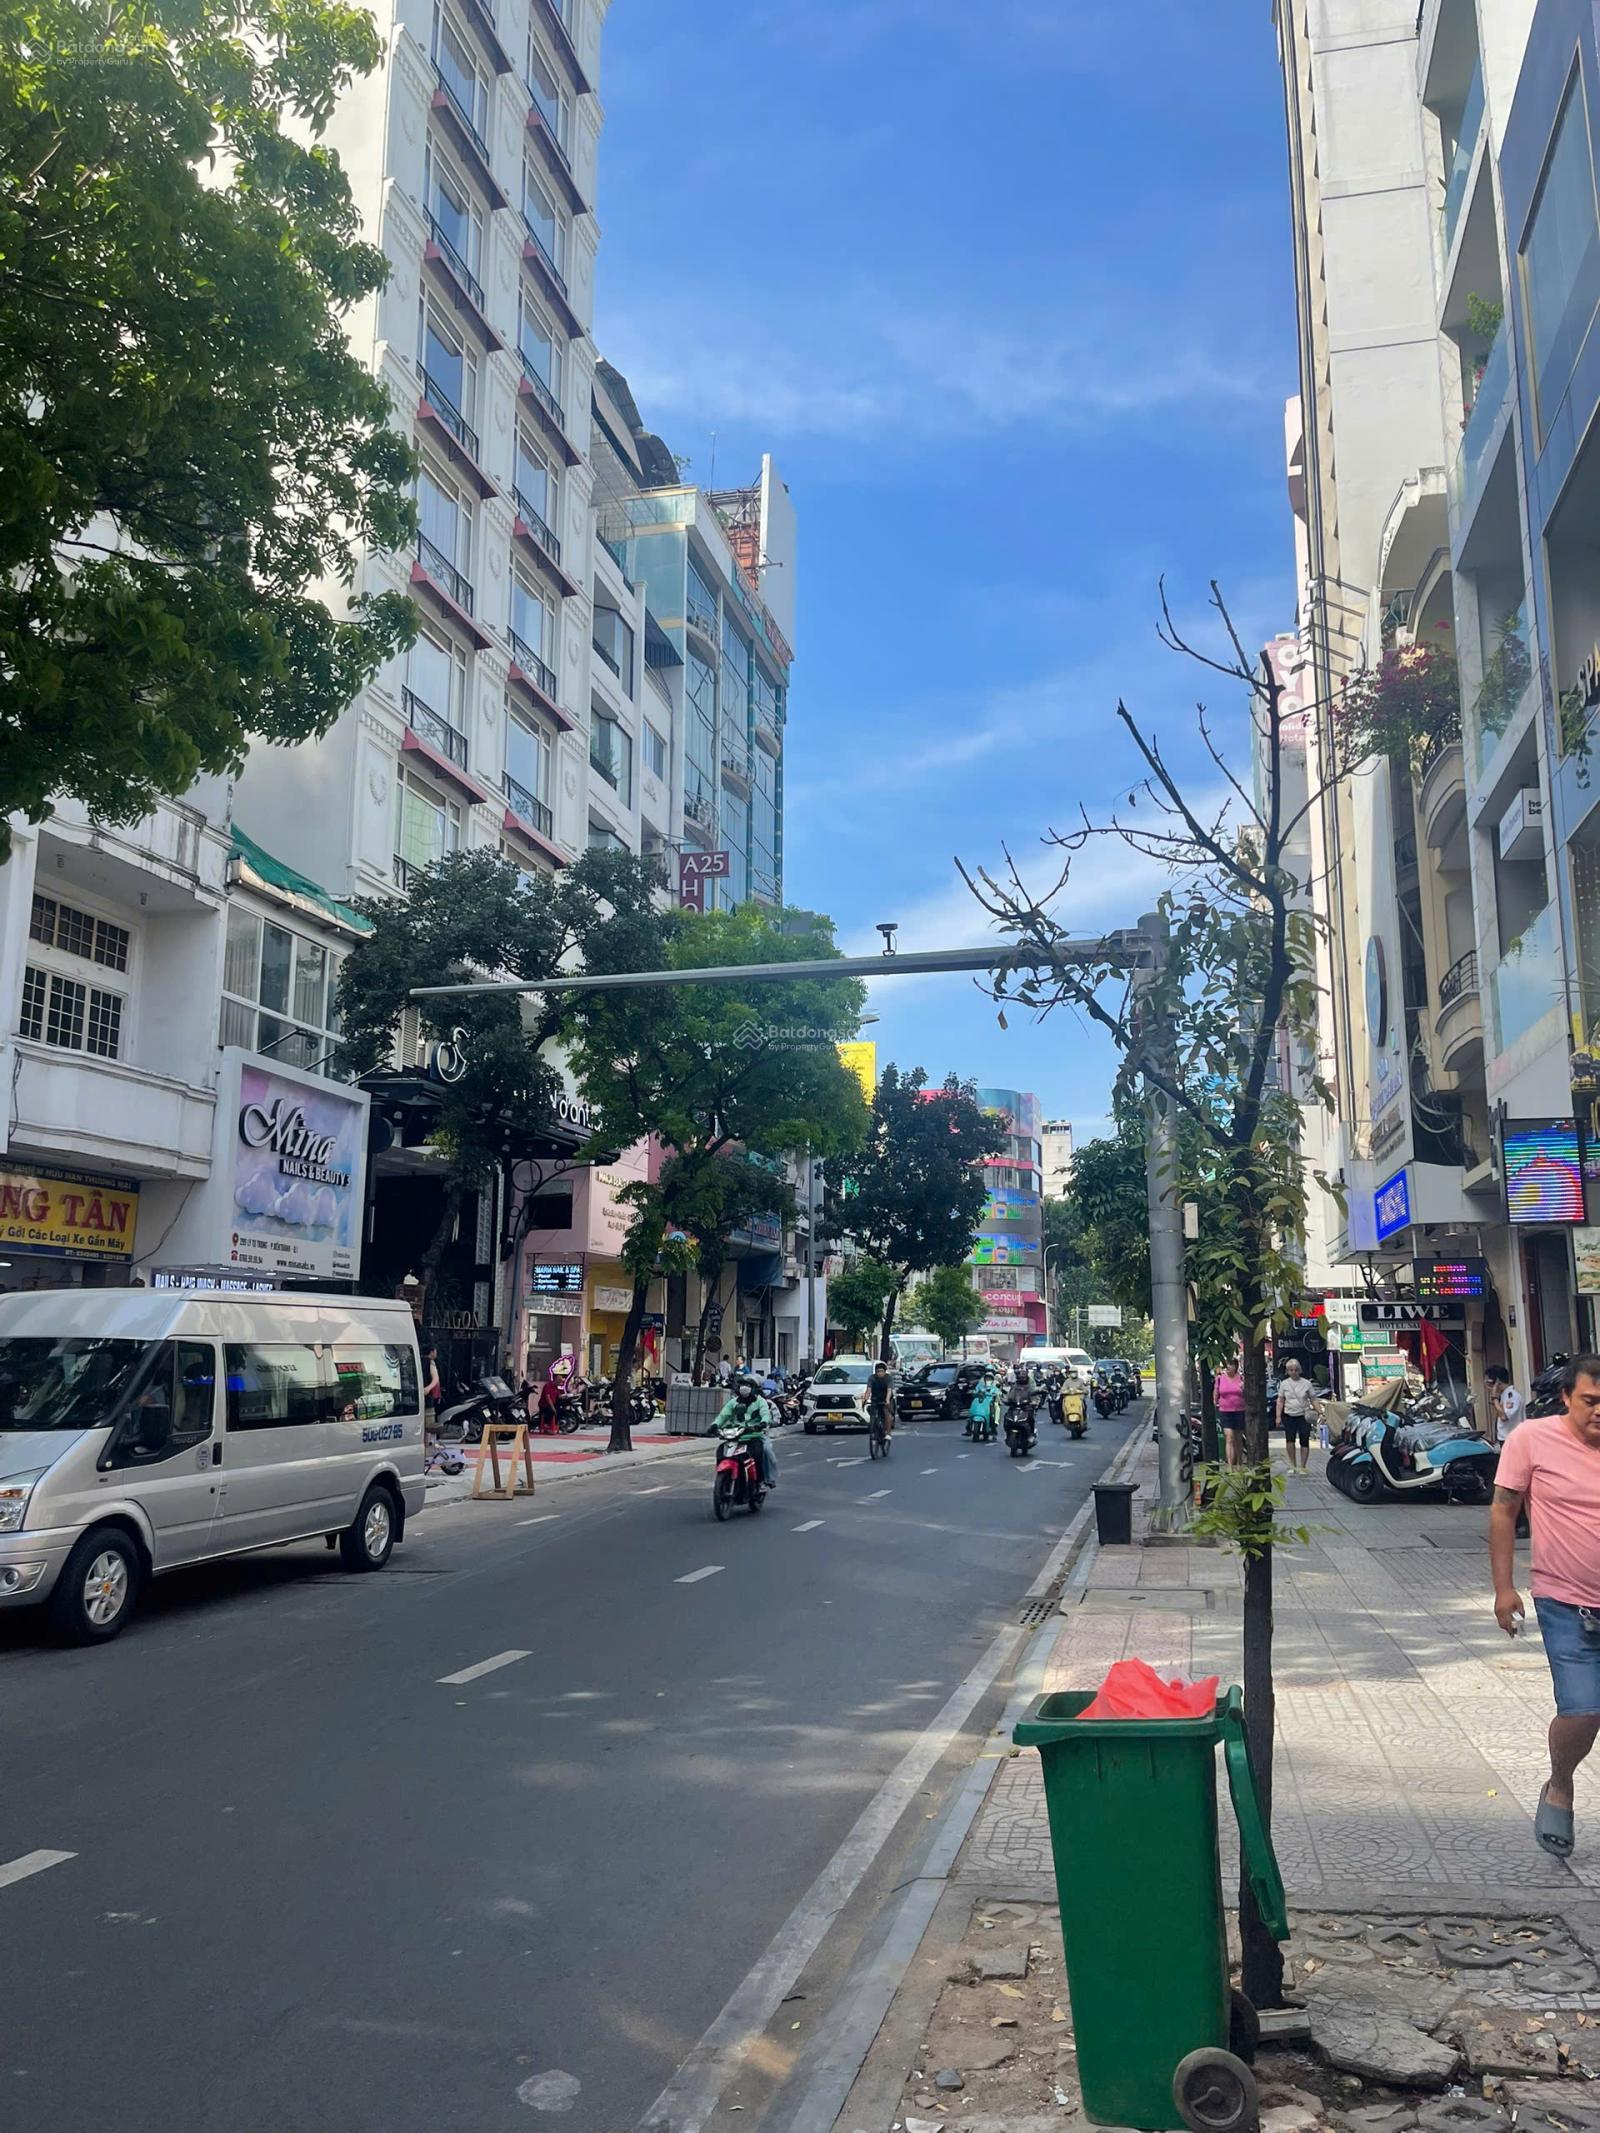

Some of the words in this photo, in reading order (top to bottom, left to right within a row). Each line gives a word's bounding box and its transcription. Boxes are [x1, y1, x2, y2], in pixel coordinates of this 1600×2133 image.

[1278, 644, 1303, 717] OYO
[683, 854, 724, 874] A25
[239, 1098, 337, 1165] Mina
[282, 1159, 308, 1177] NAILS
[309, 1165, 316, 1179] &
[316, 1167, 346, 1186] BEAUTY
[59, 1190, 131, 1233] TÂN
[28, 1228, 48, 1241] Các
[72, 1233, 85, 1245] Xe
[1376, 1304, 1449, 1320] LIWE
